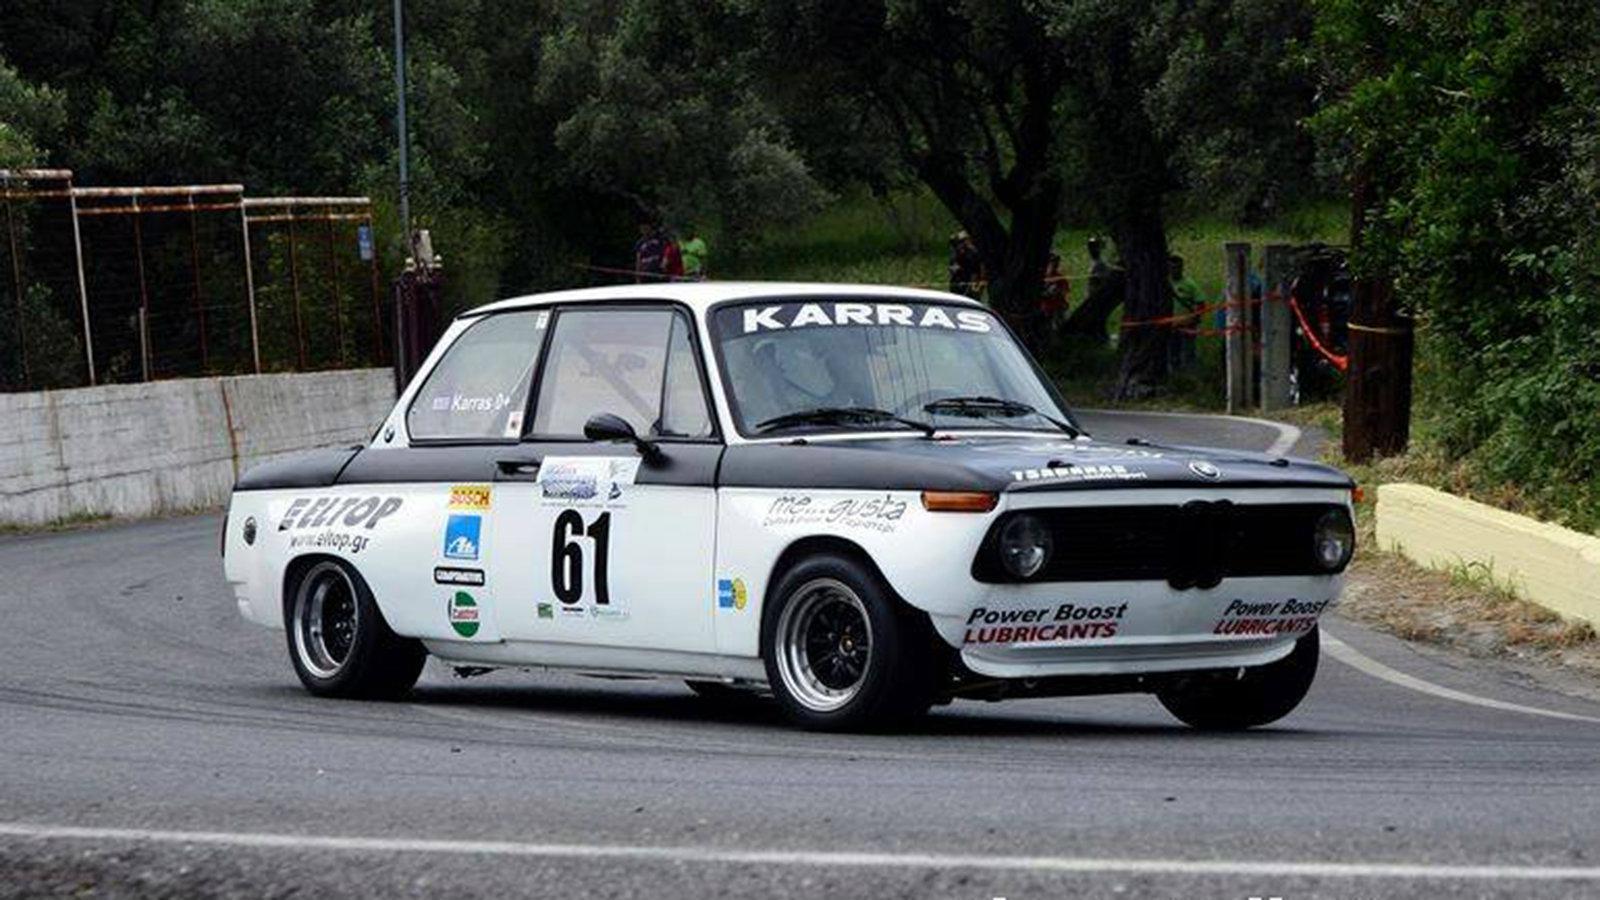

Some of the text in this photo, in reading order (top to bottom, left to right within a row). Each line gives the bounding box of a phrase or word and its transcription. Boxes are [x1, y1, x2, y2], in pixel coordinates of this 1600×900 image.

[743, 302, 991, 333] KARRAS
[450, 394, 493, 412] Karras
[551, 508, 612, 606] 61
[966, 601, 1129, 625] Power Boost
[1223, 597, 1330, 616] Power Boost
[963, 621, 1119, 645] LUBRICANTS
[1212, 616, 1319, 636] LUBRICANTS
